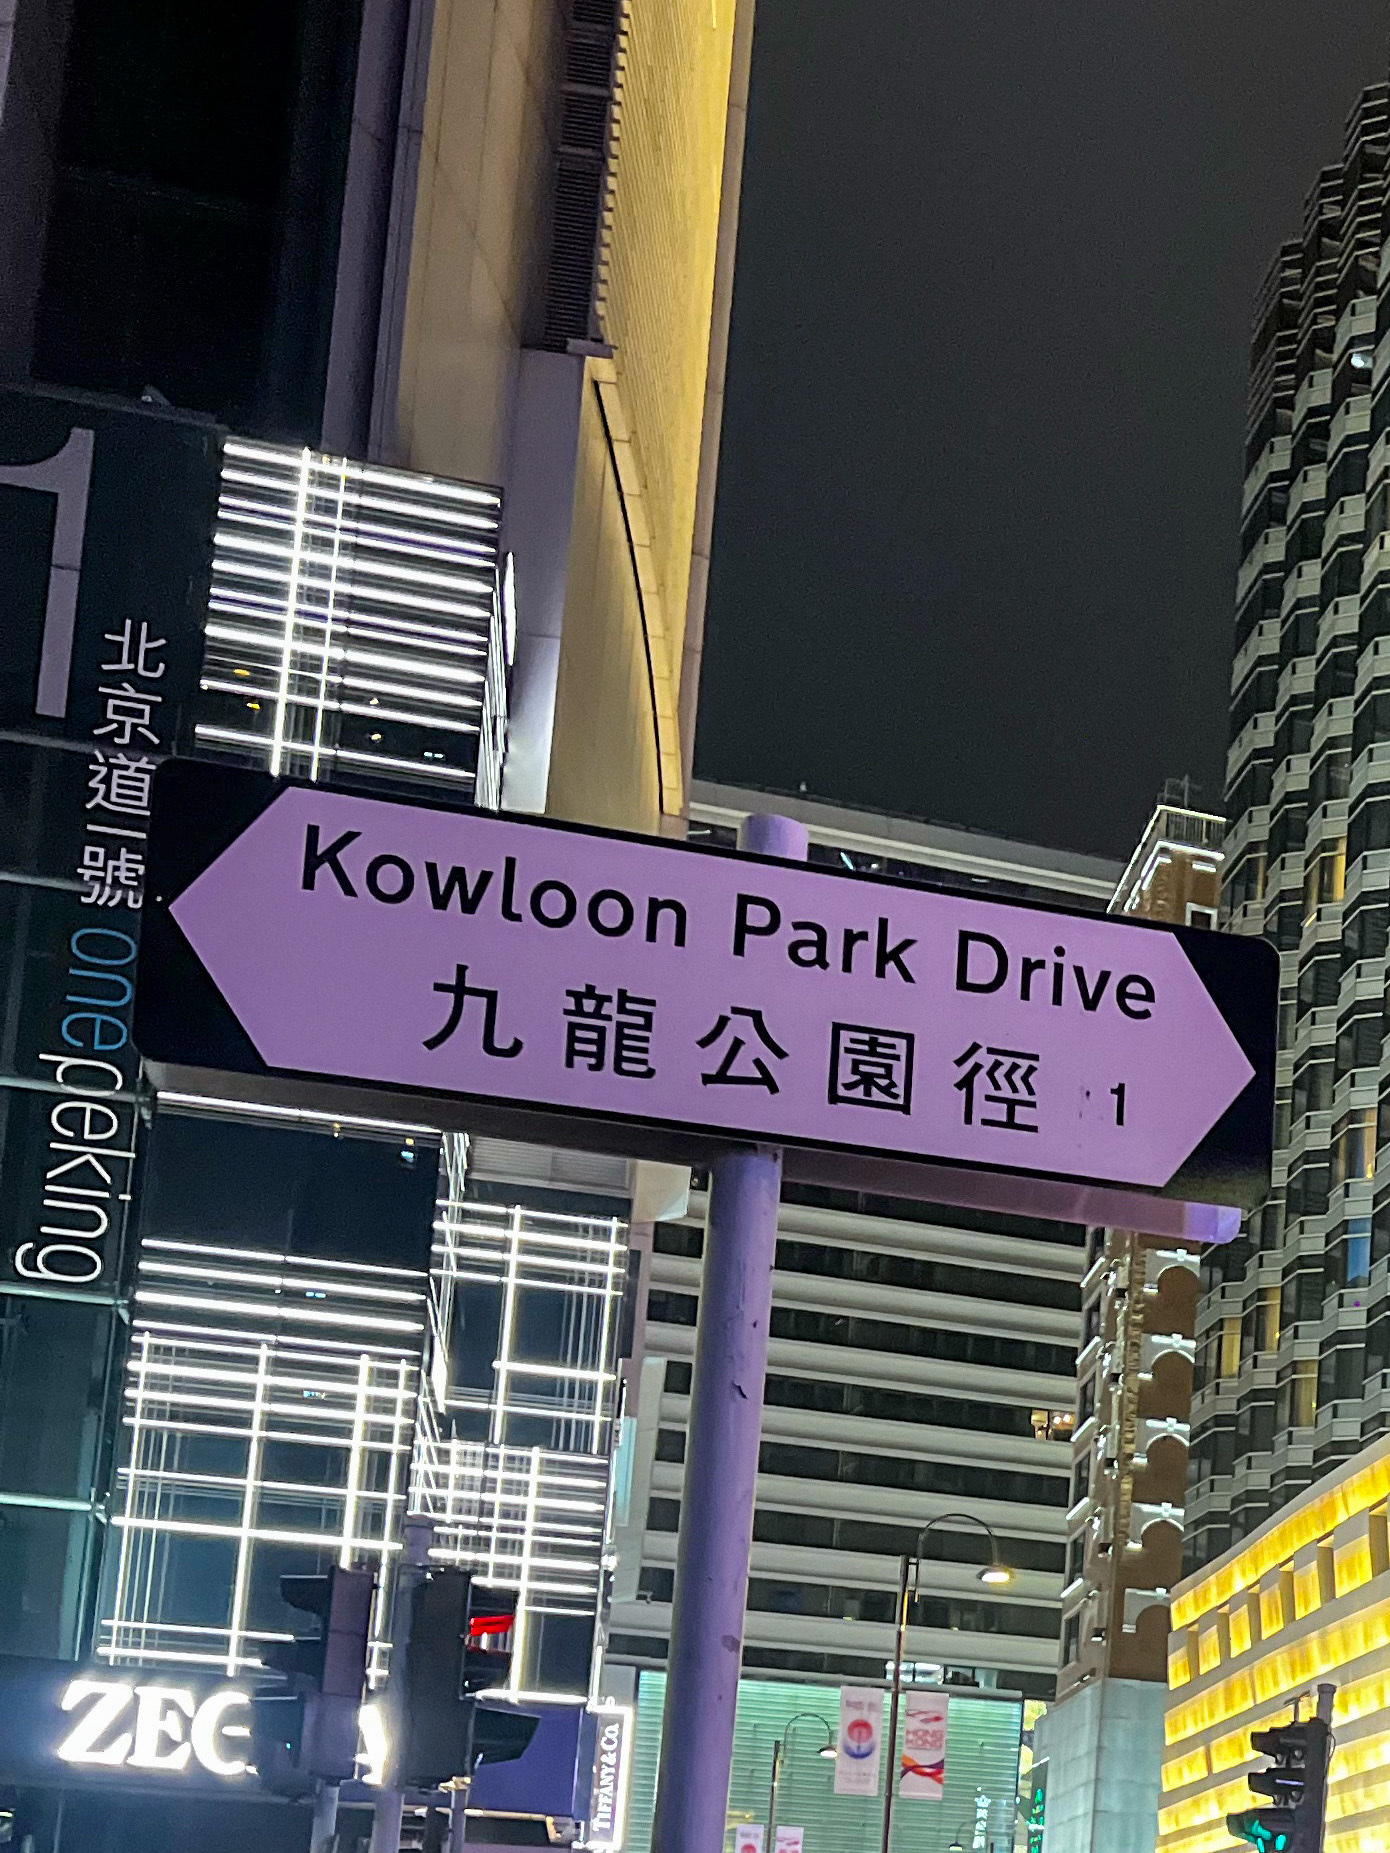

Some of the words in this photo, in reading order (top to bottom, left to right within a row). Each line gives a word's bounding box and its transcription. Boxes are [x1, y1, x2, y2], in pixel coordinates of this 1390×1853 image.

[0, 427, 94, 718] 1
[77, 617, 167, 908] 北京道一號
[302, 823, 687, 948] Kowloon
[733, 893, 918, 984] Park
[955, 929, 1156, 1020] Drive
[421, 963, 1040, 1134] 九龍公園徑
[1110, 1082, 1126, 1127] 1
